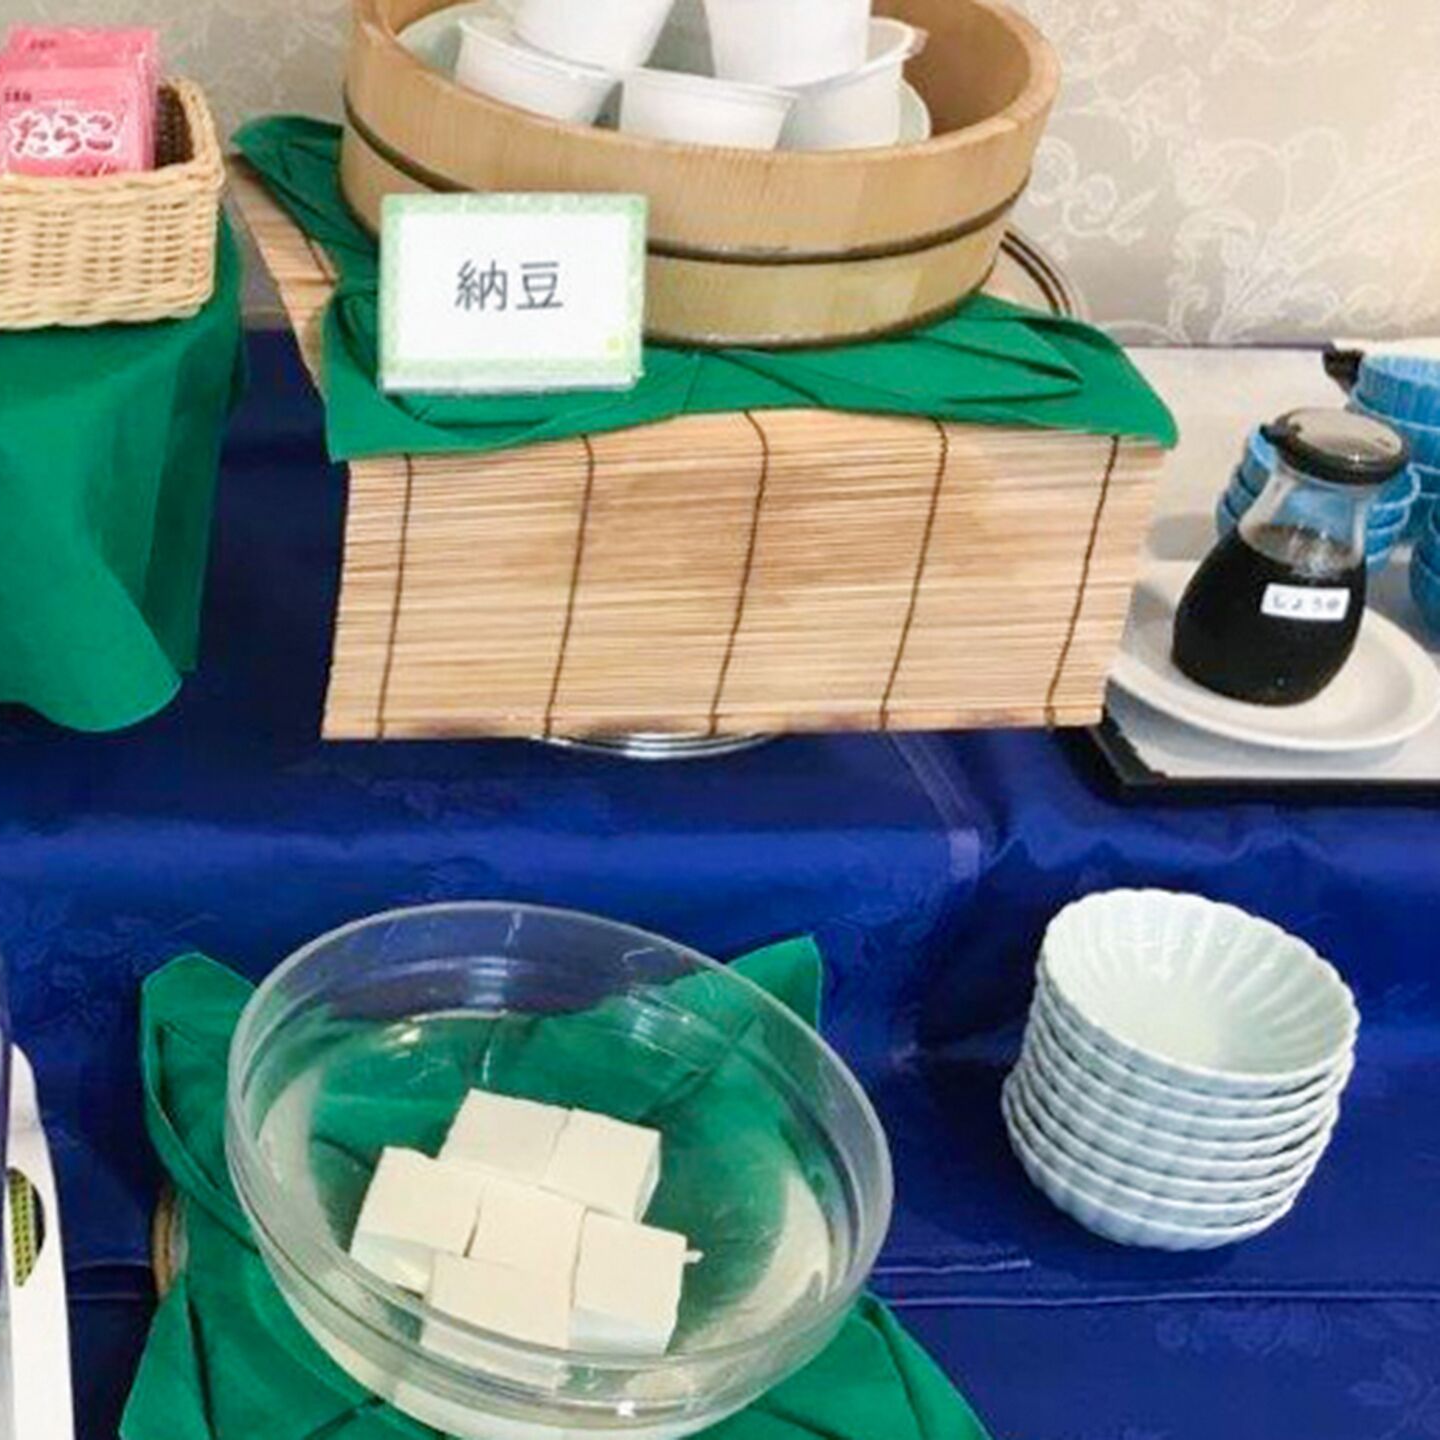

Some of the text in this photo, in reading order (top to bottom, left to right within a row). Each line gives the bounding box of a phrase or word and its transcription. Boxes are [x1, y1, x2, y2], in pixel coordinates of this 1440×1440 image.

[12, 113, 116, 155] たらこ
[454, 259, 564, 313] 納豆
